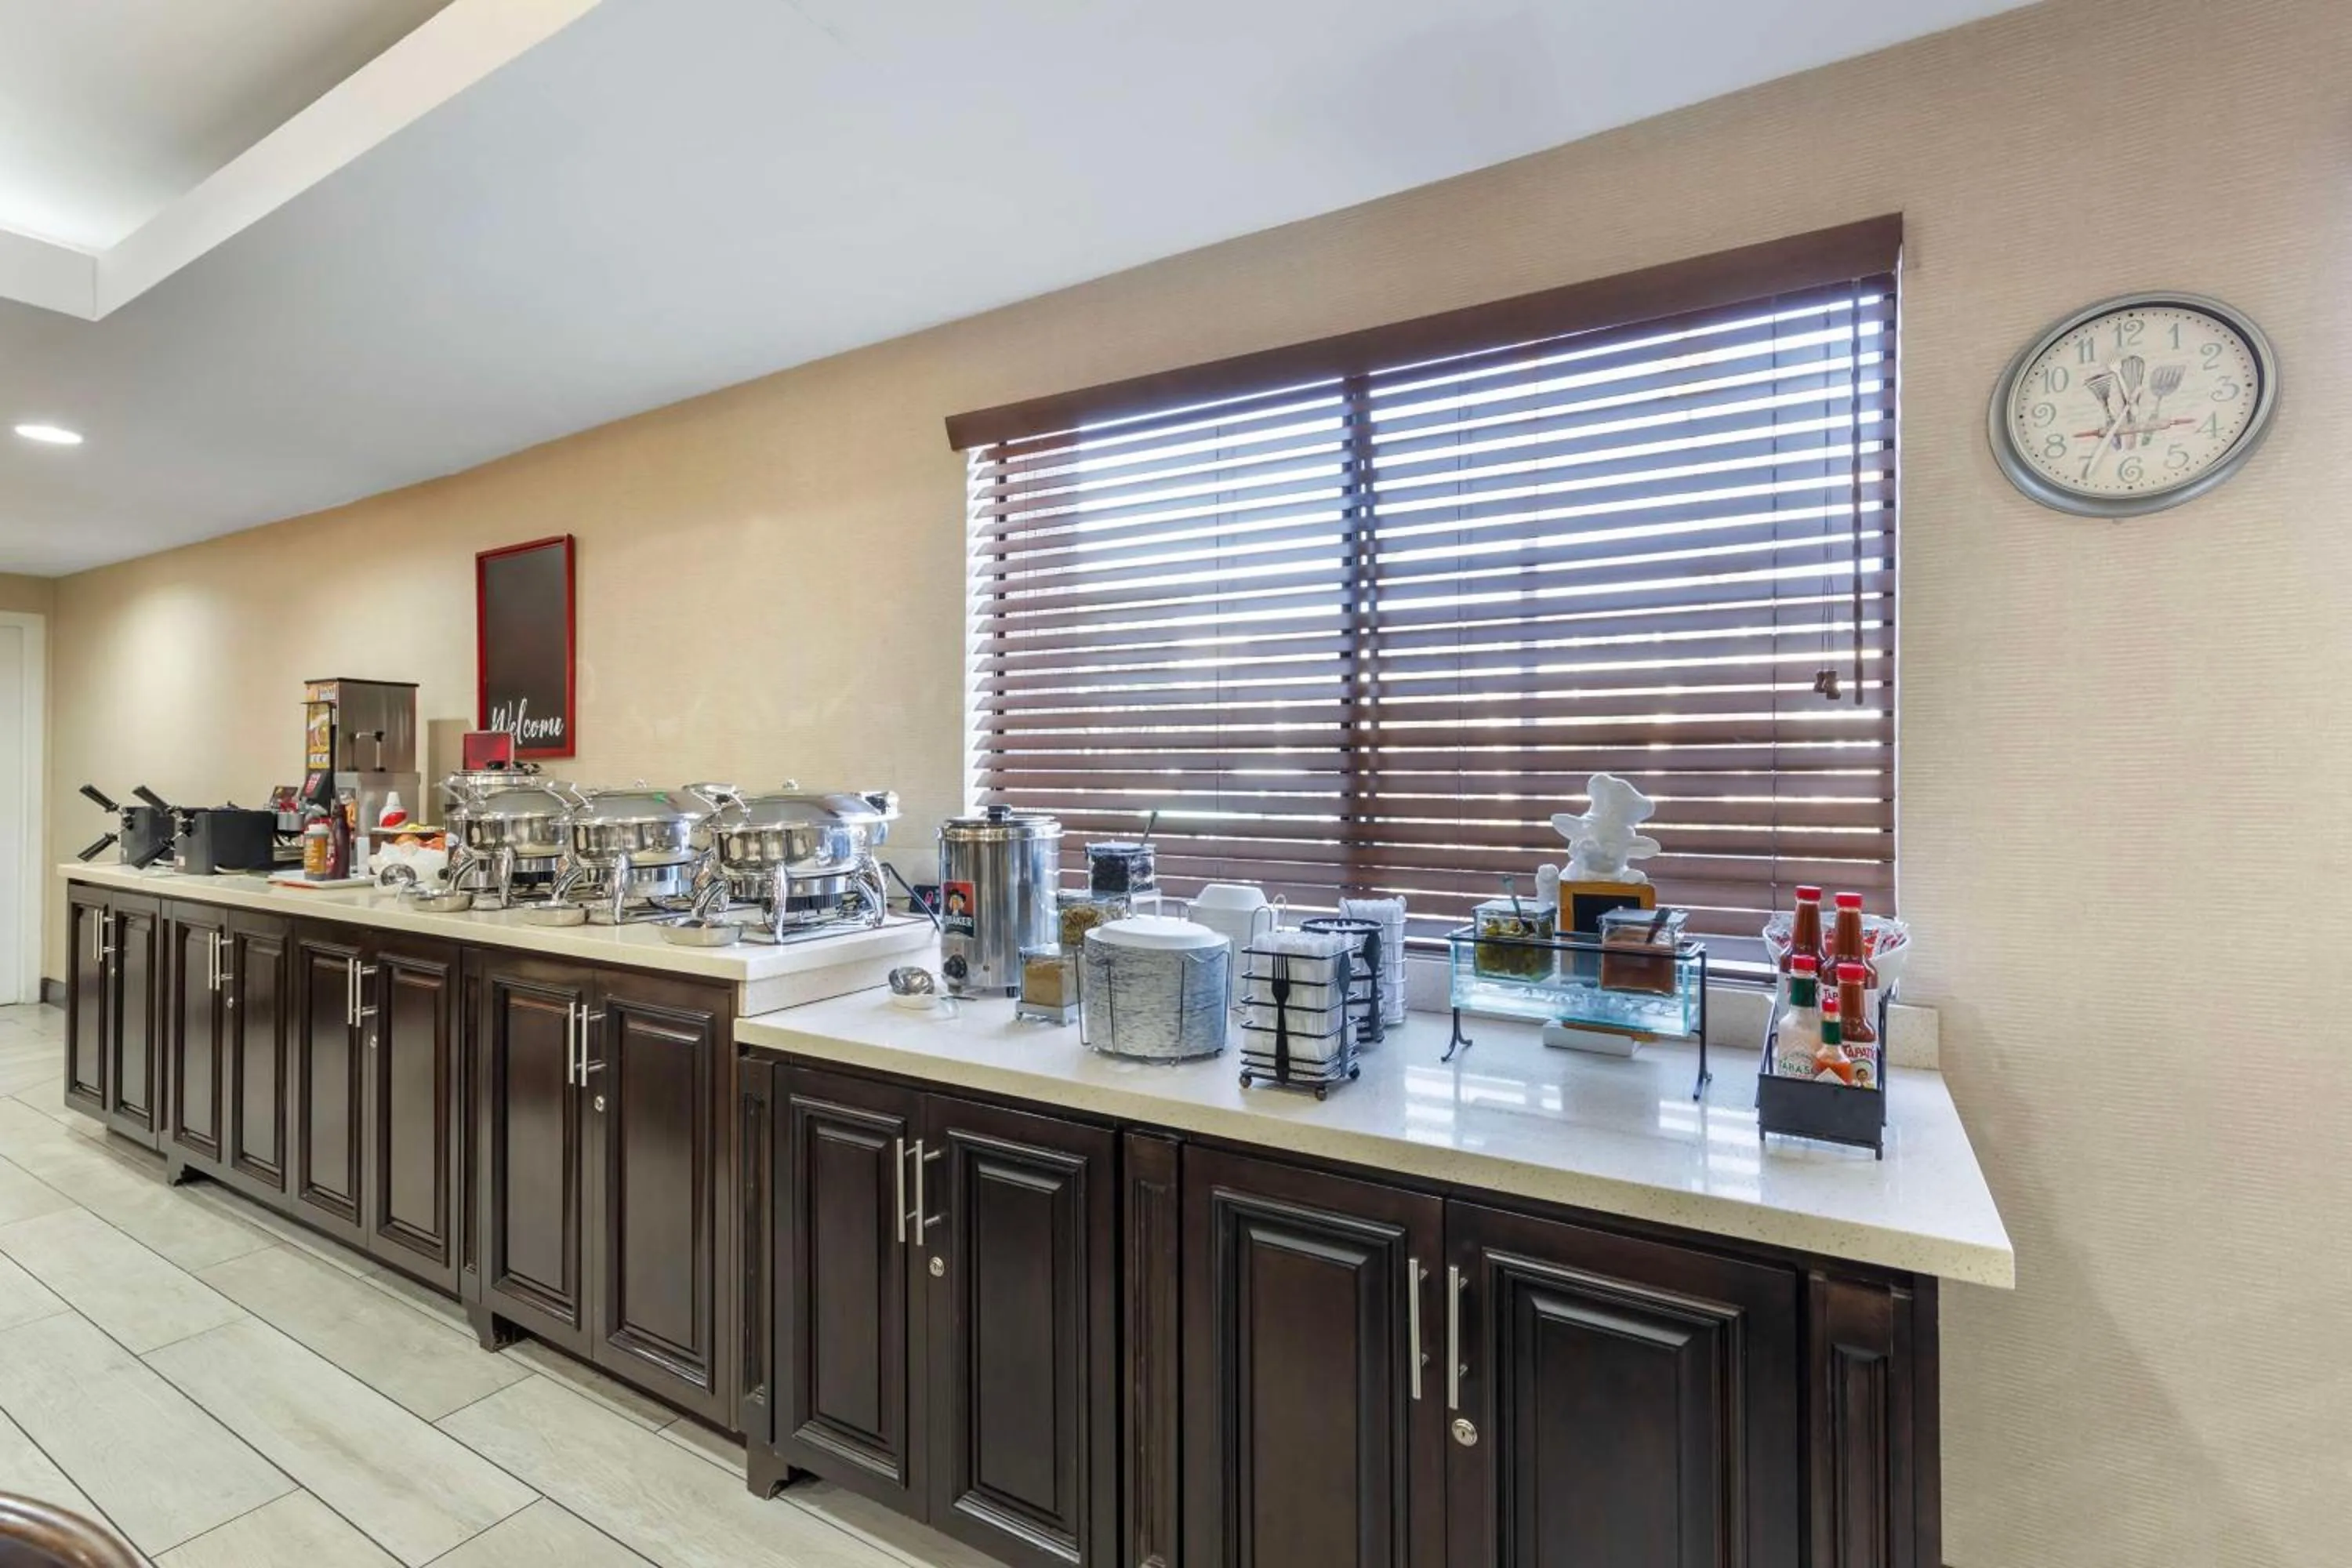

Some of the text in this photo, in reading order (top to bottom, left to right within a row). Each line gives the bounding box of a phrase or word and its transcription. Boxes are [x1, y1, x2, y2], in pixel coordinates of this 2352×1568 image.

[2115, 319, 2145, 348] 12
[2168, 323, 2180, 350] 1
[2075, 337, 2096, 364] 11
[2200, 343, 2222, 370] 2
[2042, 366, 2069, 394] 10
[2210, 376, 2240, 402] 3
[2031, 401, 2056, 427] 9
[2196, 412, 2224, 438] 4
[2044, 433, 2067, 459] 8
[2164, 443, 2190, 470] 5
[2078, 455, 2096, 480] 7
[2118, 456, 2143, 483] 6
[491, 697, 564, 745] Welcome
[1779, 1059, 1813, 1073] TABAS
